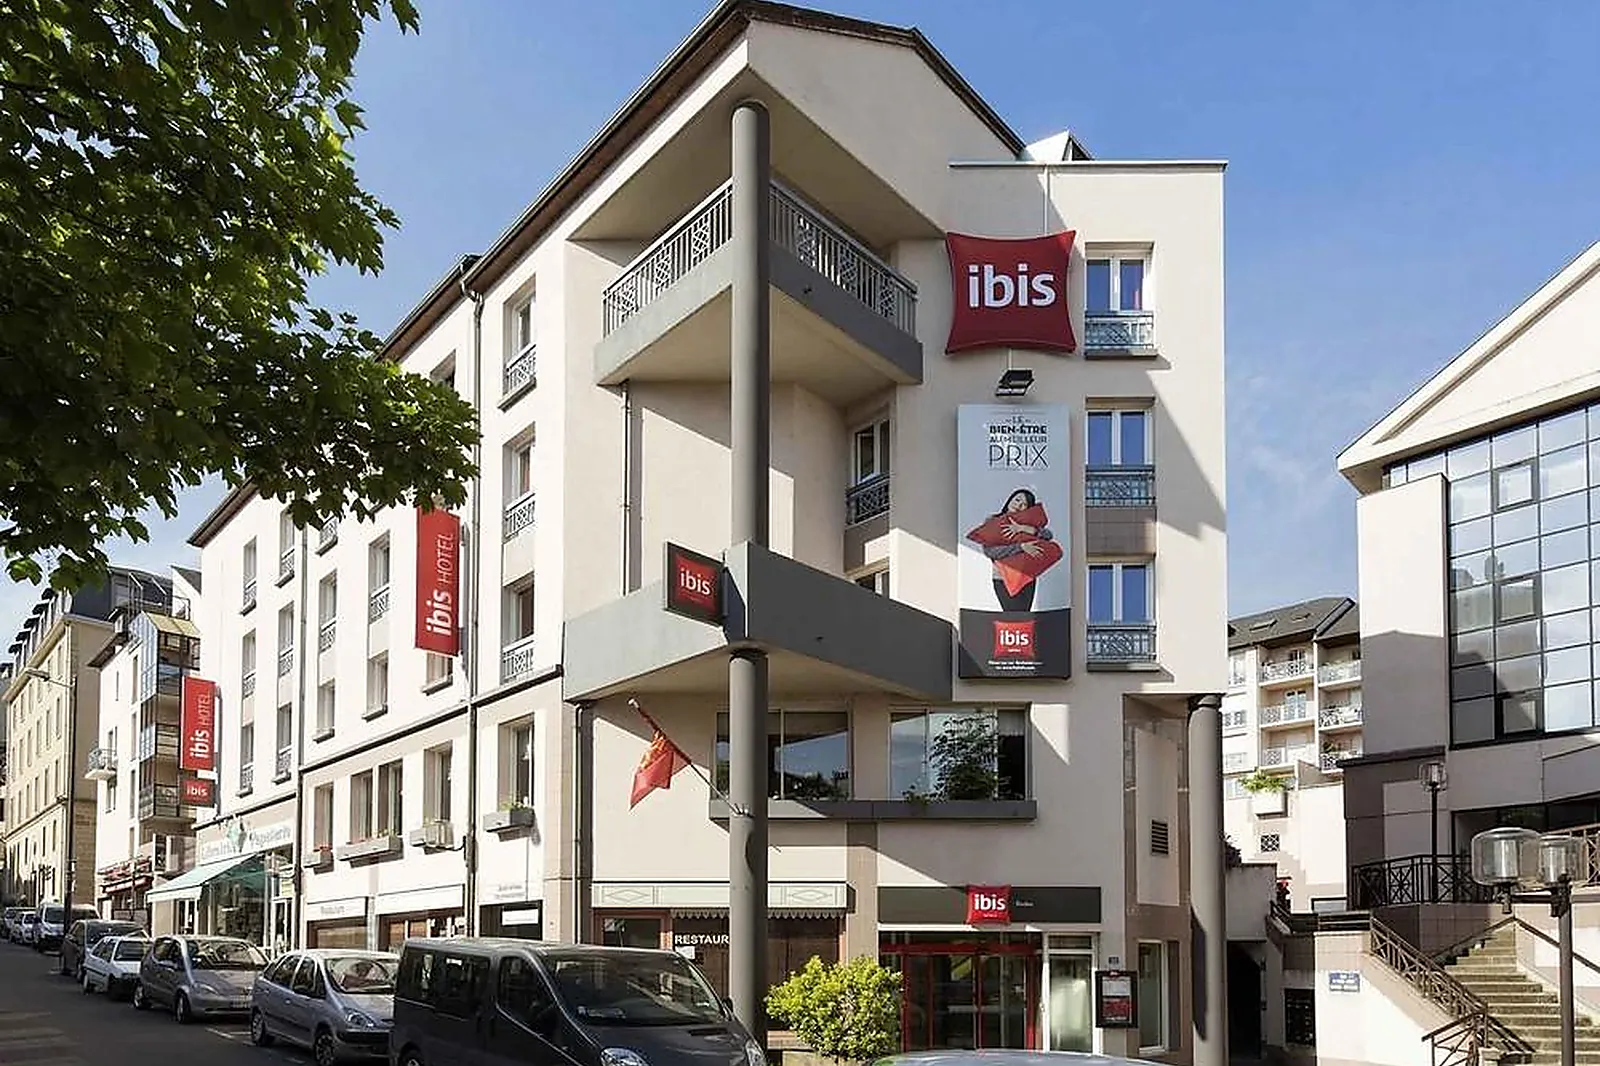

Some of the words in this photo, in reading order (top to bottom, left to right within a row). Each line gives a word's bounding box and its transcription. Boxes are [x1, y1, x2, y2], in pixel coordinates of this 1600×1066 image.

[969, 263, 1056, 308] ibis
[989, 444, 1049, 467] PRIX
[436, 533, 454, 584] HOTEL
[680, 567, 711, 595] ibis
[426, 589, 452, 636] ibis
[999, 629, 1029, 646] ibis
[190, 729, 210, 759] ibis
[186, 785, 208, 797] ibis
[974, 894, 1006, 911] ibis
[674, 934, 730, 945] RESTAUR
